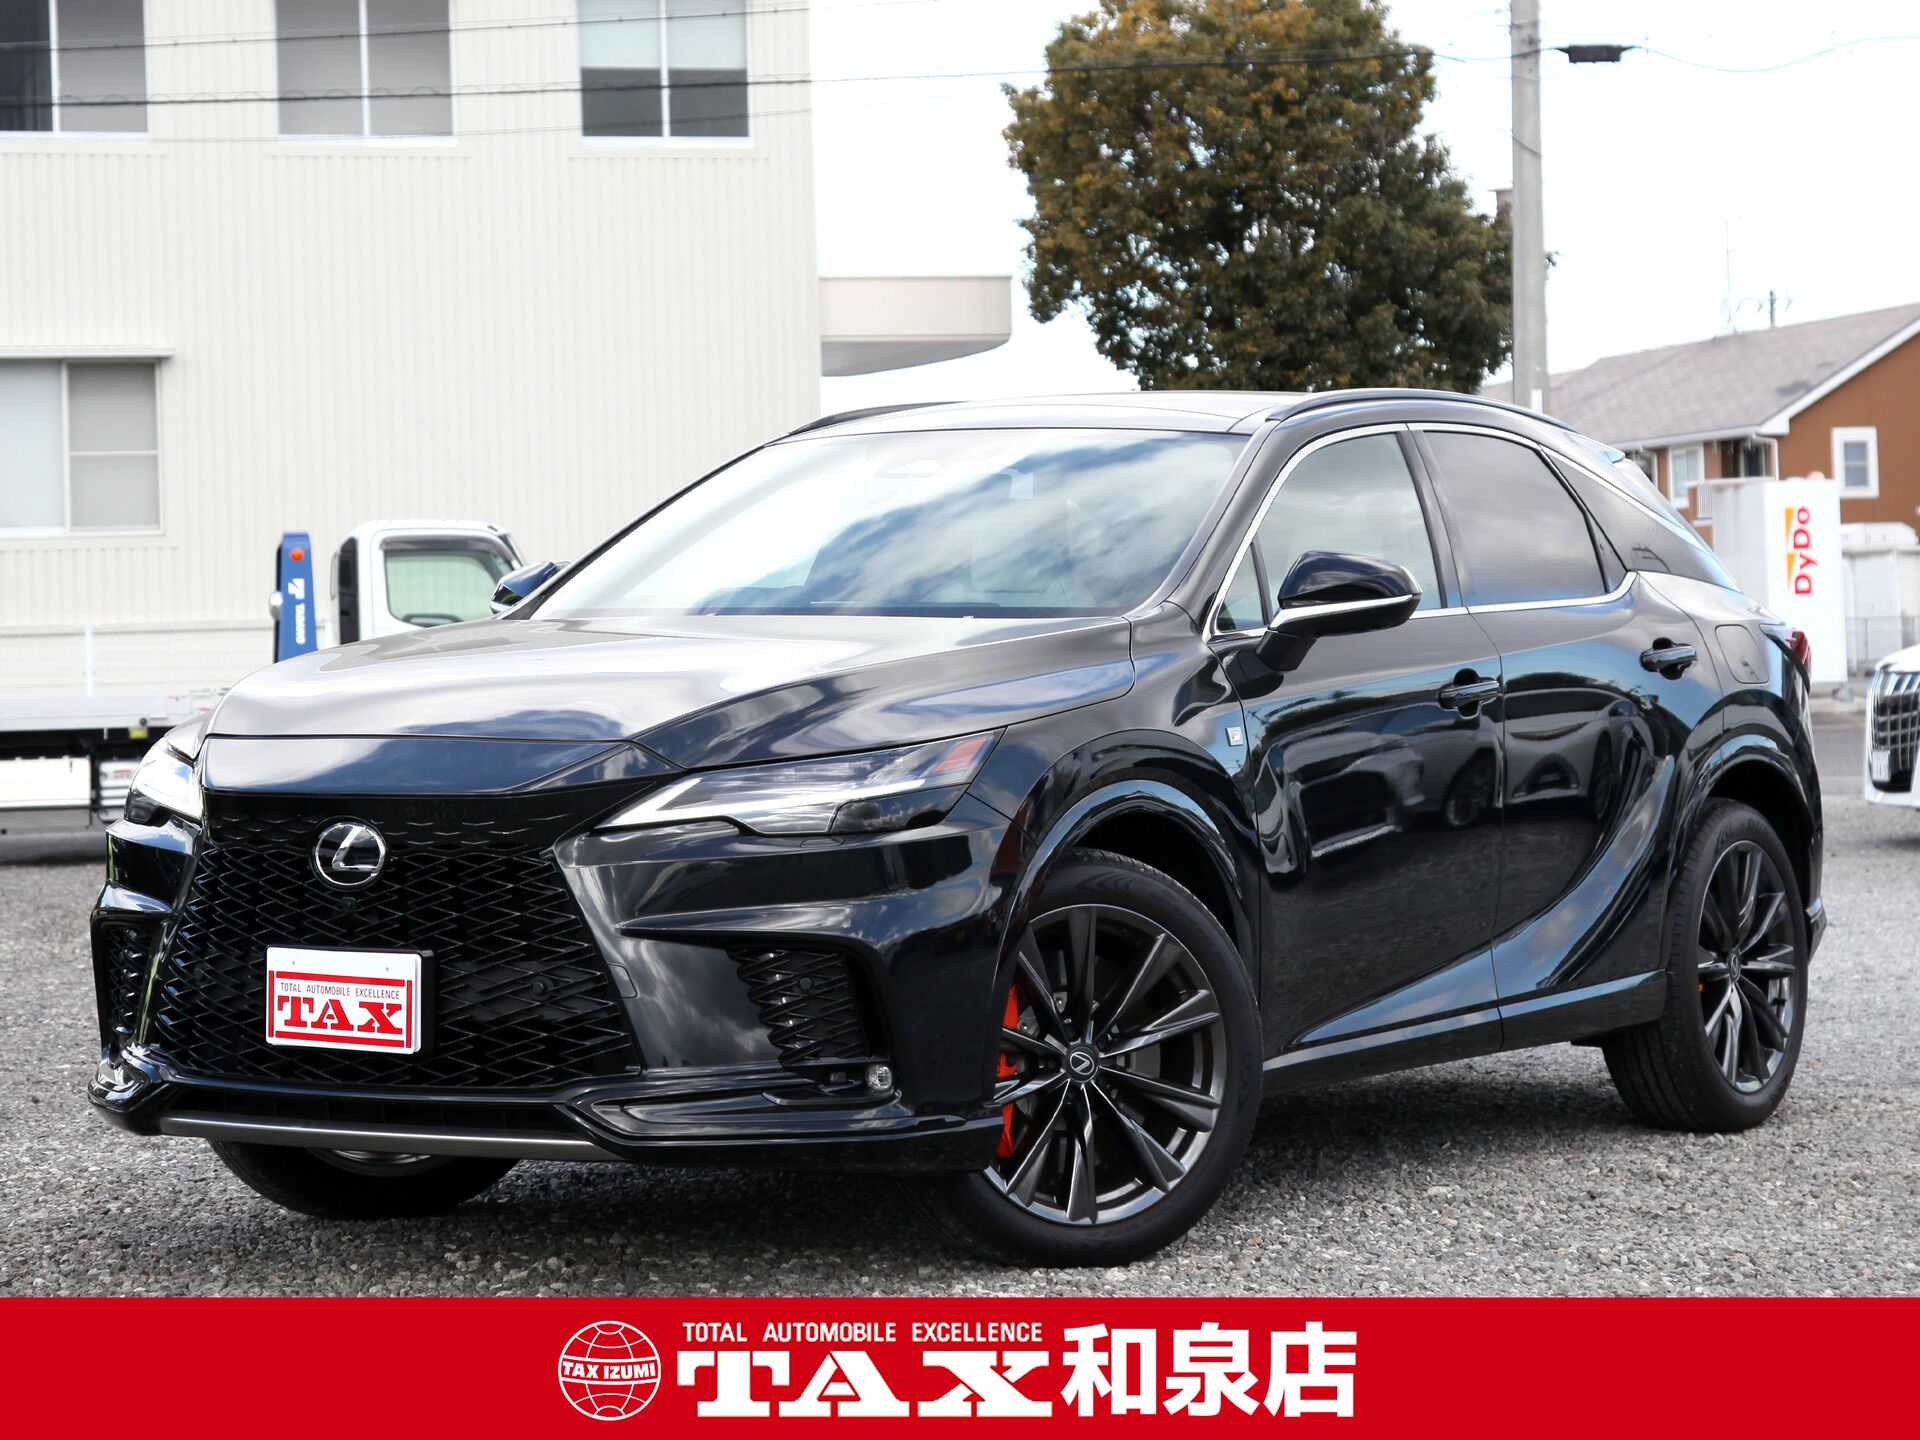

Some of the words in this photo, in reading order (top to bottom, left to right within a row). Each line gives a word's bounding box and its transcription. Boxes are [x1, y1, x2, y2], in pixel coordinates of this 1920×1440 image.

[1793, 506, 1818, 595] DyDo
[280, 982, 302, 993] TOTAL
[306, 984, 350, 997] AUTOMOBILE
[355, 987, 400, 1000] EXCELLENCE
[277, 995, 403, 1035] TAX
